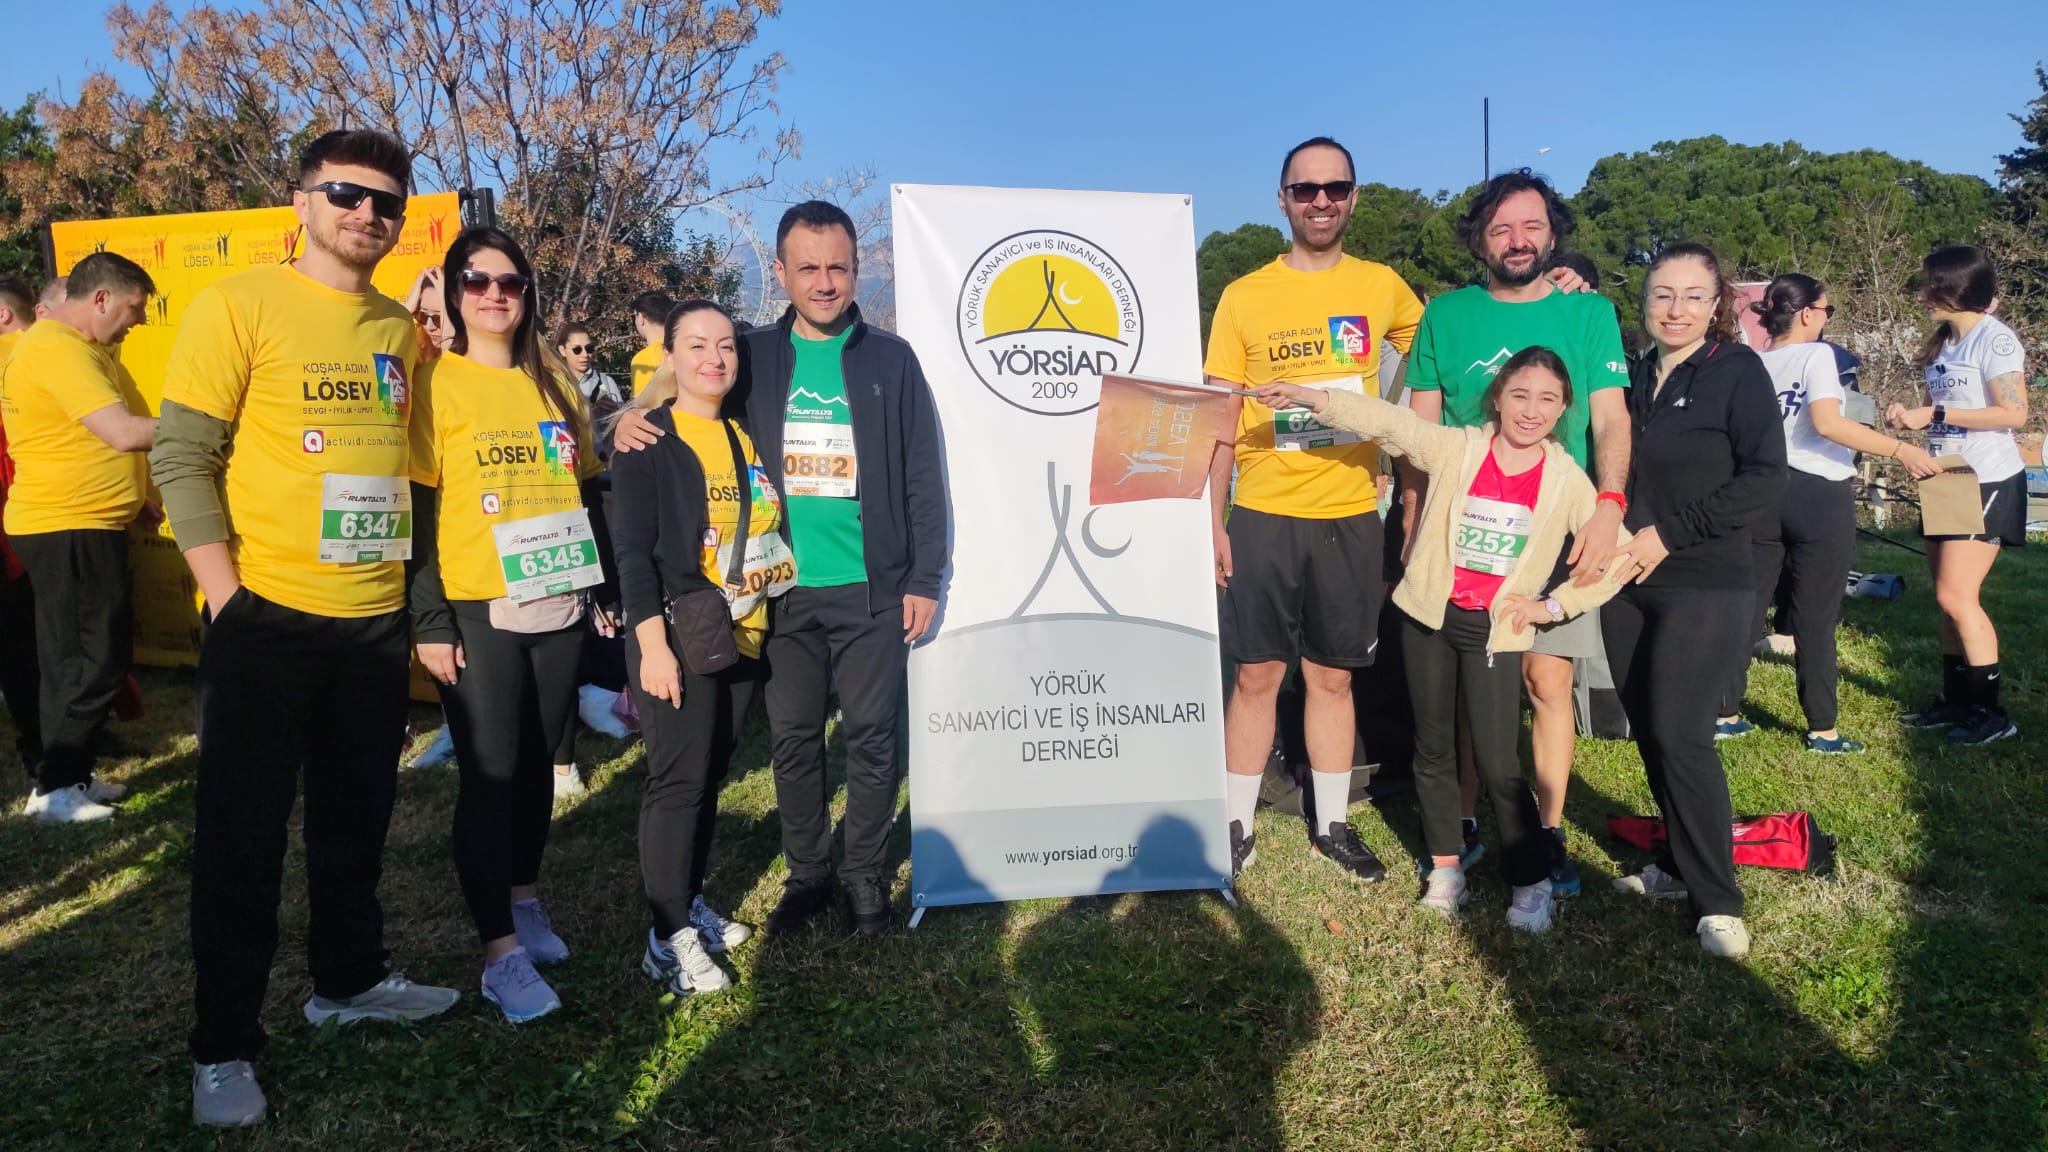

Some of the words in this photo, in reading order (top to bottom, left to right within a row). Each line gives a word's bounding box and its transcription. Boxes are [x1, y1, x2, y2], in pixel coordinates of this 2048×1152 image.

[184, 254, 214, 268] LÖSEV
[249, 252, 280, 265] LÖSEV
[964, 285, 983, 329] YÖRÜK
[1026, 241, 1041, 250] ve
[1268, 330, 1298, 342] KOŞAR
[1300, 328, 1323, 336] ADIM
[988, 344, 1118, 376] YÖRSİAD
[1268, 340, 1325, 362] LÖSEV
[303, 363, 342, 375] KOŞAR
[345, 363, 369, 374] ADIM
[303, 377, 372, 401] LÖSEV
[1032, 381, 1078, 399] 2009
[1288, 411, 1320, 433] 62
[473, 431, 508, 443] KOŞAR
[511, 431, 534, 439] ADIM
[475, 442, 538, 467] LÖSEV
[347, 495, 387, 503] RUNTALYA
[340, 512, 402, 538] 6347
[520, 531, 559, 545] RUNTALYA
[1456, 525, 1517, 556] 6252
[519, 543, 585, 577] 6345
[1030, 669, 1107, 697] YÖRÜK
[928, 704, 1029, 734] SANAYİCİ
[1034, 707, 1063, 729] VE
[1070, 702, 1089, 733] İŞ
[1096, 701, 1206, 727] İNSANLARI
[1021, 733, 1119, 763] DERNEĞİ
[1005, 843, 1138, 866] www.yorsiad.org.tr
